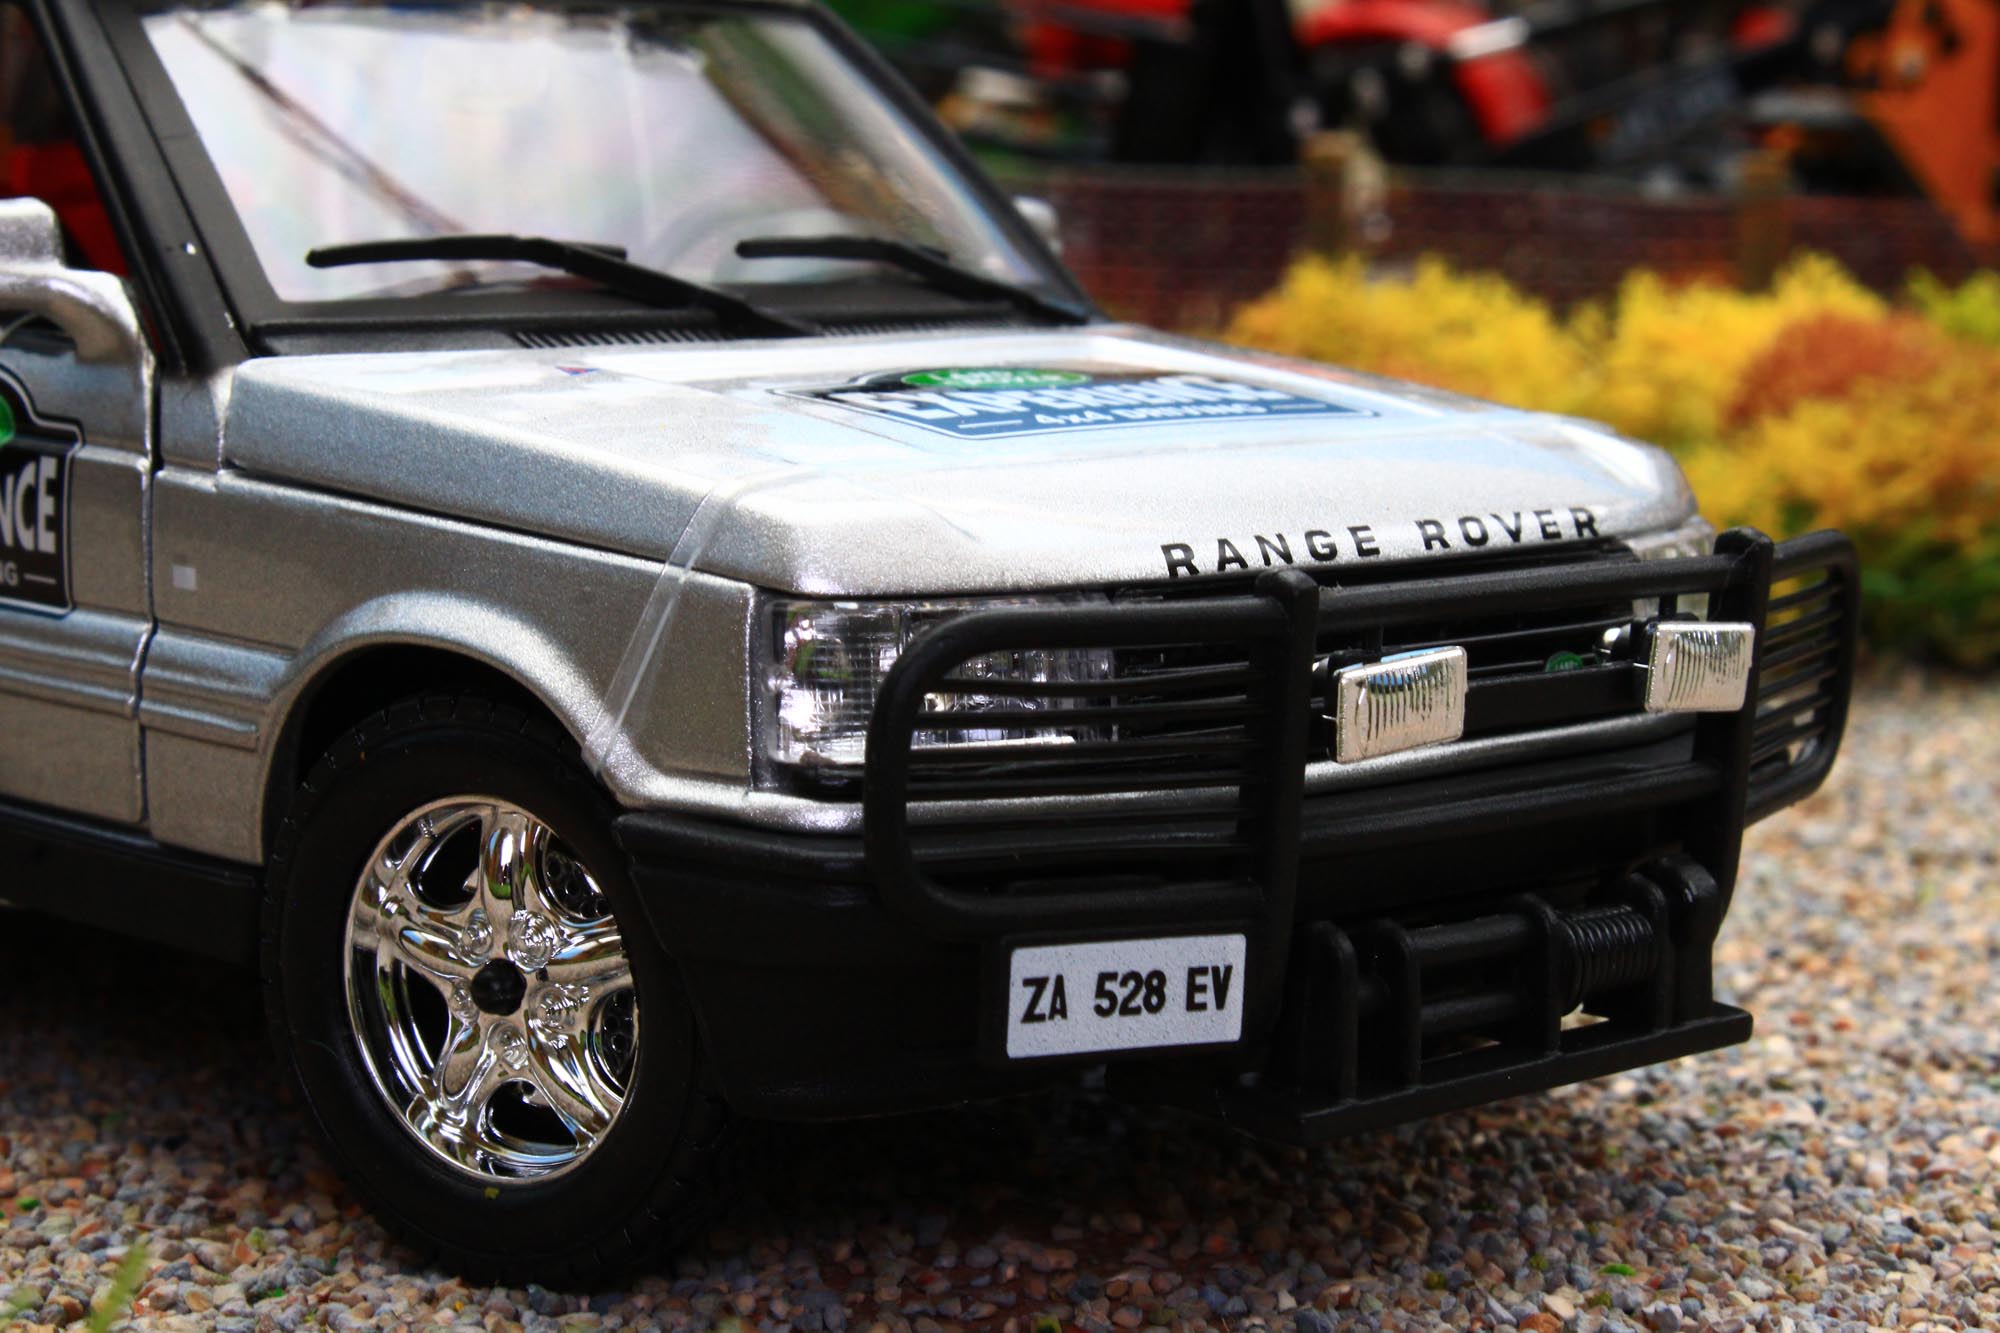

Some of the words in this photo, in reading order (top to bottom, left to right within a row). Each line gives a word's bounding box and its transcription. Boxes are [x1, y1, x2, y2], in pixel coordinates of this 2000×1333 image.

[1160, 524, 1380, 579] RANGE
[1414, 507, 1600, 551] ROVER
[1020, 973, 1068, 1024] ZA
[1093, 969, 1167, 1018] 528
[1186, 964, 1233, 1012] EV
